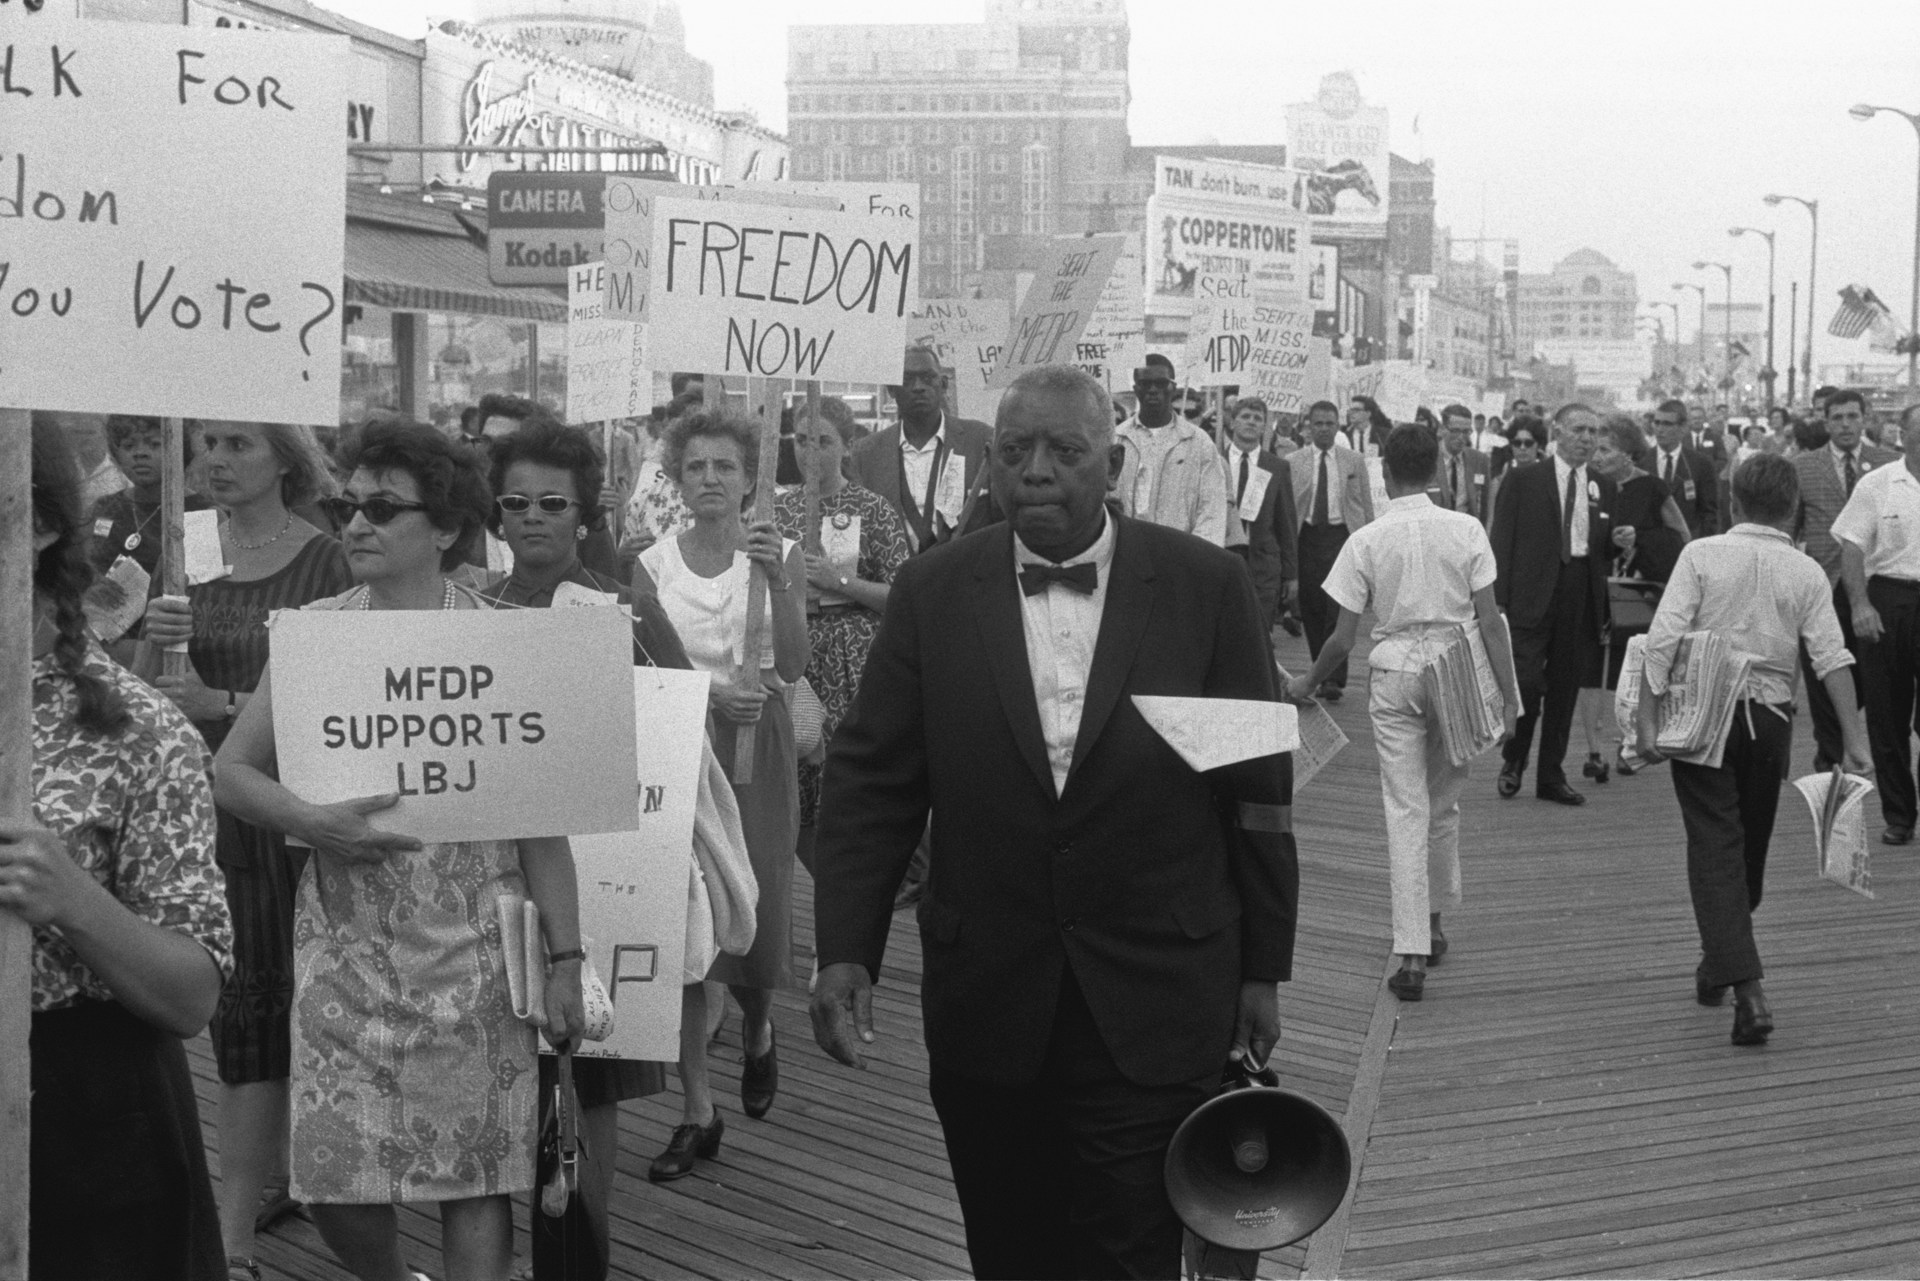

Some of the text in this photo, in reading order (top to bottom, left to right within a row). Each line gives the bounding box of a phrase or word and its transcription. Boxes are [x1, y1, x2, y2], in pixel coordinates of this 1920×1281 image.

[0, 44, 82, 98] LK
[1165, 167, 1193, 188] TAN
[501, 189, 586, 213] CAMERA
[1180, 216, 1297, 253] COPPERTONE
[505, 241, 589, 267] Kodak
[1057, 250, 1099, 277] SEAT
[666, 218, 912, 318] FREEDOM
[1051, 280, 1079, 301] THE
[1201, 273, 1251, 298] Seat
[134, 260, 335, 381] Vote?
[1252, 307, 1297, 325] SEAT
[725, 316, 835, 376] NOW
[1006, 309, 1079, 366] MFDP
[1254, 327, 1307, 349] MISS.
[628, 324, 644, 416] DEMOCRACY
[1251, 347, 1309, 369] REEDOM
[1256, 390, 1303, 411] PARTY
[384, 664, 494, 702] MFDP
[322, 711, 546, 749] SUPPORTS
[397, 759, 477, 797] LBJ
[598, 881, 637, 896] THE
